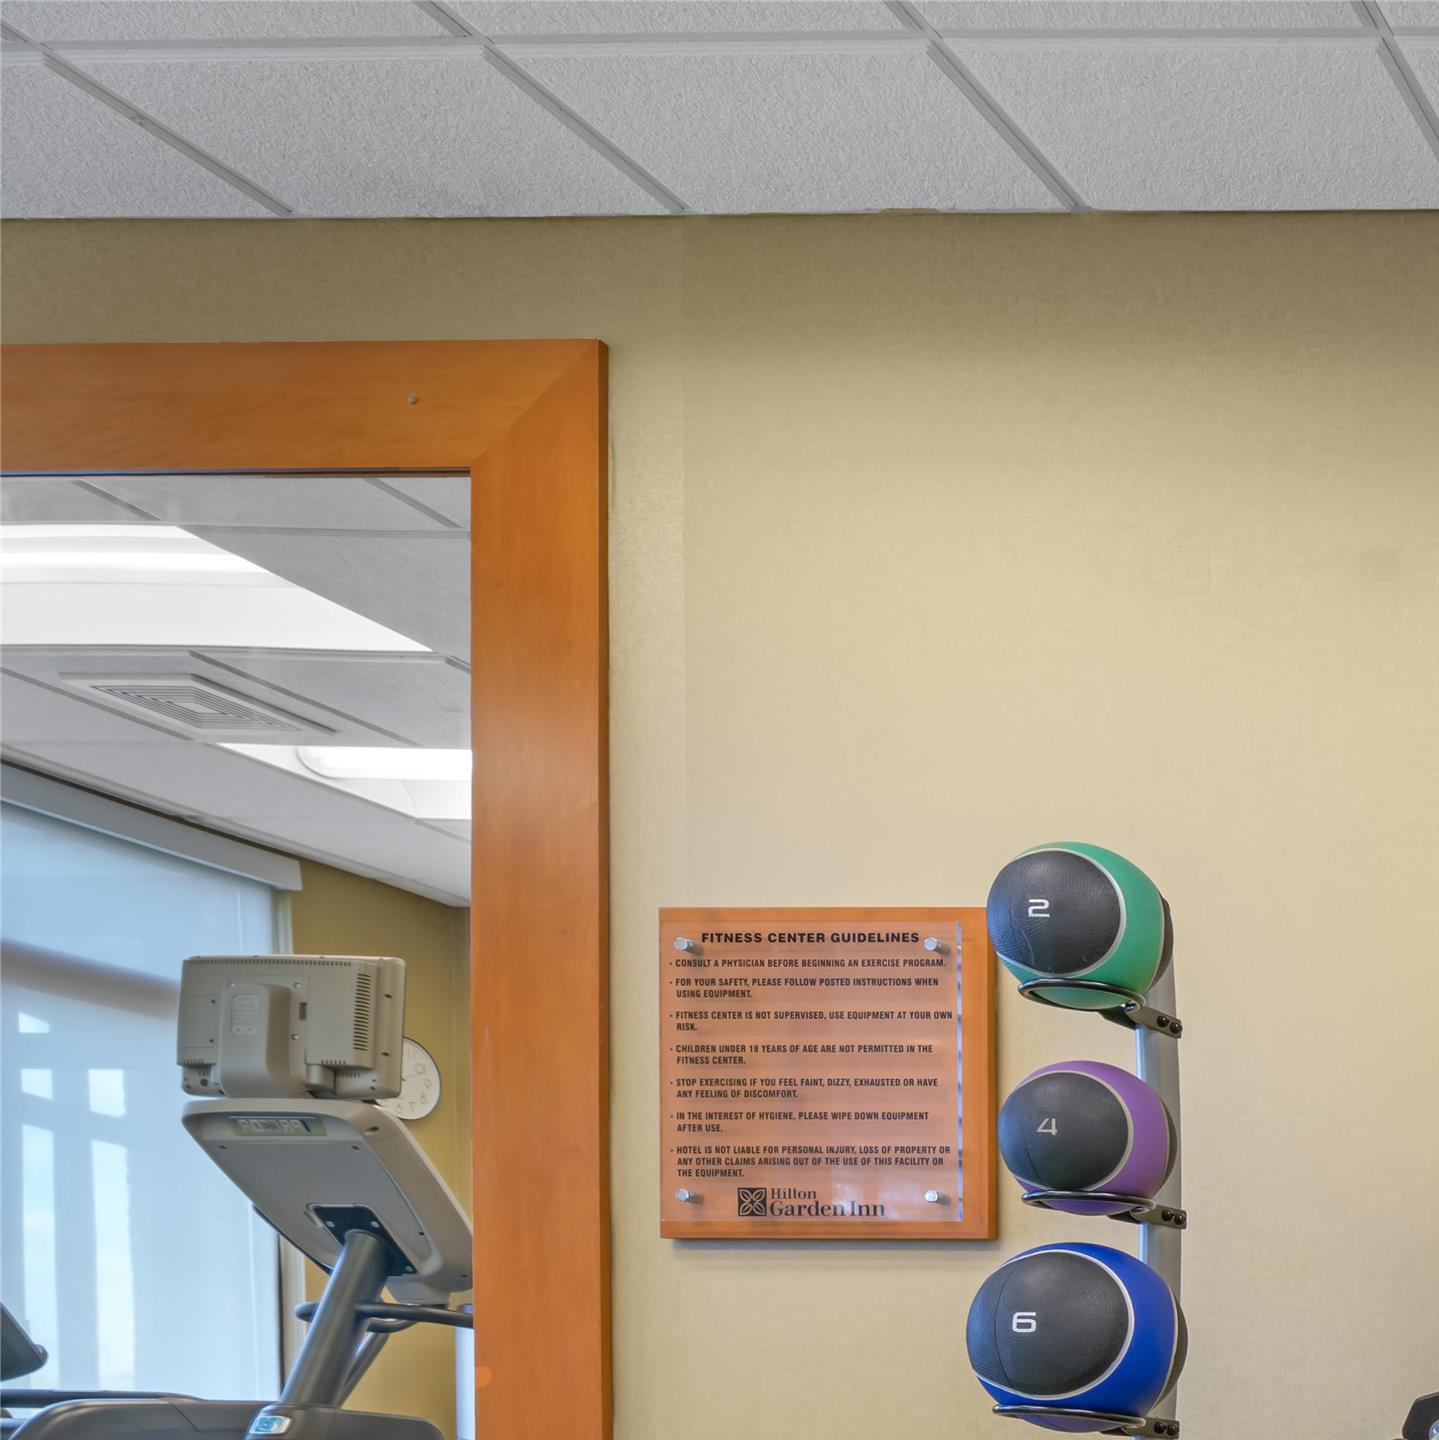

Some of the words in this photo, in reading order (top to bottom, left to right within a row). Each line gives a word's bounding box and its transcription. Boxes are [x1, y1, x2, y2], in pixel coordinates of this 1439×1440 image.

[1029, 899, 1049, 917] 2
[701, 932, 762, 944] FITNESS
[767, 932, 825, 944] CENTER
[830, 932, 919, 944] GUIDELINES
[675, 958, 710, 969] CONSULT
[714, 958, 719, 969] A
[722, 958, 764, 969] PHYSICIAN
[768, 958, 798, 969] BEFORE
[802, 958, 845, 969] BEGINNING
[848, 958, 858, 969] AN
[862, 958, 900, 969] EXERCISE
[903, 958, 946, 969] PROGRAM.
[676, 977, 691, 988] FOR
[694, 977, 716, 988] YOUR
[719, 977, 750, 988] SAFETY,
[752, 977, 781, 988] PLEASE
[784, 977, 816, 988] FOLLOW
[819, 977, 850, 988] POSTED
[853, 977, 912, 988] INSTRUCTIONS
[915, 977, 938, 988] WHEN
[677, 989, 700, 999] USING
[704, 989, 753, 999] EQUIPMENT.
[676, 1011, 708, 1021] FITNESS
[711, 1011, 742, 1021] CENTER
[745, 1011, 752, 1021] IS
[756, 1011, 770, 1021] NOT
[774, 1011, 827, 1021] SUPERVISED,
[829, 1011, 844, 1021] USE
[848, 1011, 894, 1021] EQUIPMENT
[897, 1011, 906, 1021] AT
[910, 1011, 931, 1021] YOUR
[934, 1011, 952, 1021] OWN
[677, 1022, 698, 1032] RISK.
[1037, 1119, 1057, 1135] 4
[771, 1187, 817, 1200] Hilton
[769, 1200, 845, 1218] Garden
[850, 1201, 886, 1217] Inn
[1012, 1312, 1036, 1332] 6
